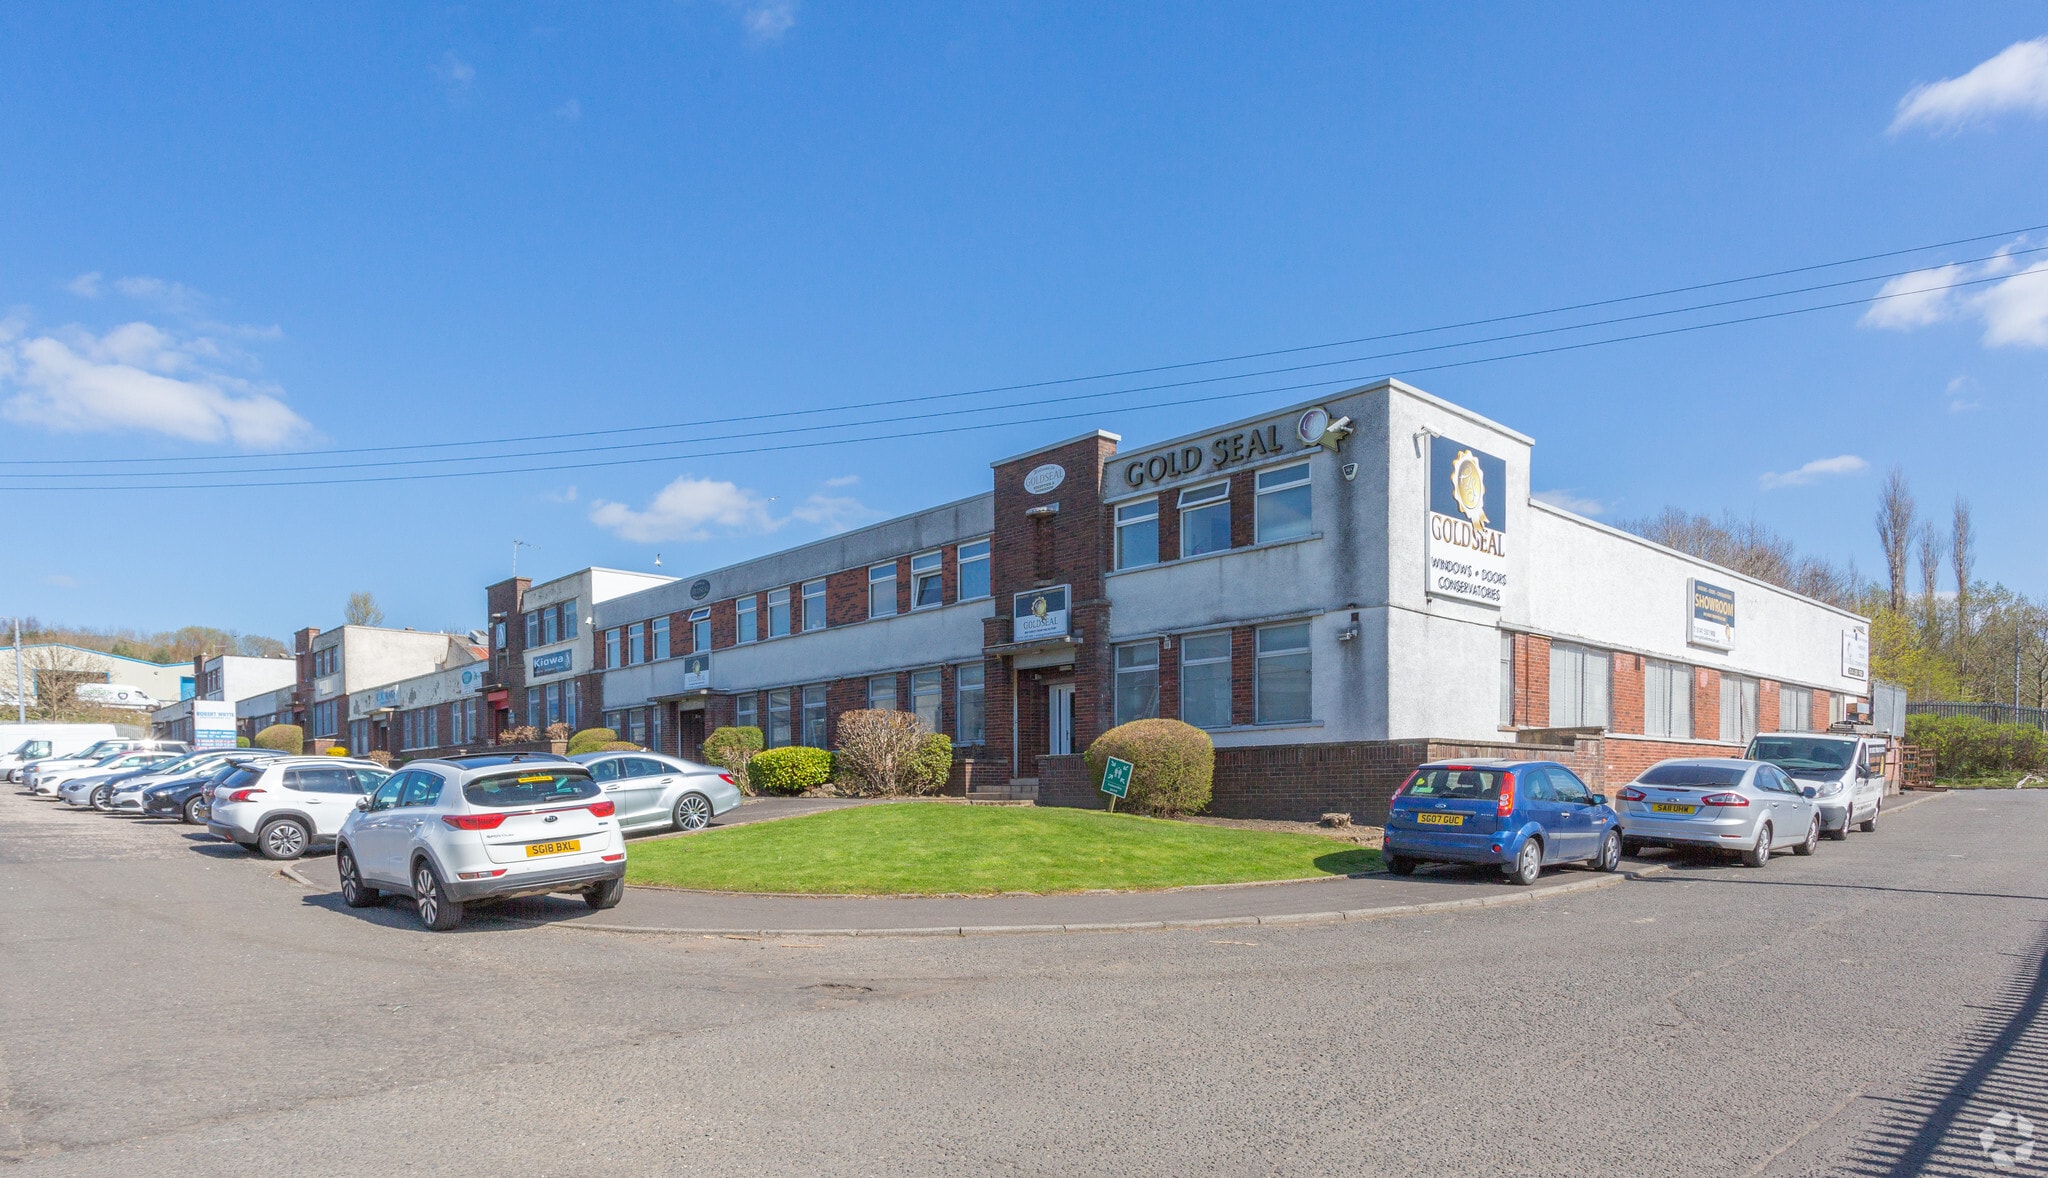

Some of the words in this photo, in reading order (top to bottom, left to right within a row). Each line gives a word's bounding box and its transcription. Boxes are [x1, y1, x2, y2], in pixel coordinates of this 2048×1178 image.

[1124, 446, 1202, 487] GOLD
[1213, 425, 1283, 466] SEAL
[1026, 470, 1063, 487] GOLDSEAL
[1432, 514, 1505, 557] GOLDSEAL
[1431, 556, 1472, 577] WINDOWS
[1482, 569, 1507, 586] DOORS
[1438, 576, 1500, 601] CONSERVATORIES
[1695, 593, 1734, 616] SHOWROOM
[1023, 616, 1058, 630] GOLDSEAL
[534, 655, 564, 668] Kiowa
[1421, 814, 1442, 824] SG07
[1443, 815, 1460, 825] GUC
[532, 843, 554, 855] SG18
[556, 841, 575, 852] BXL
